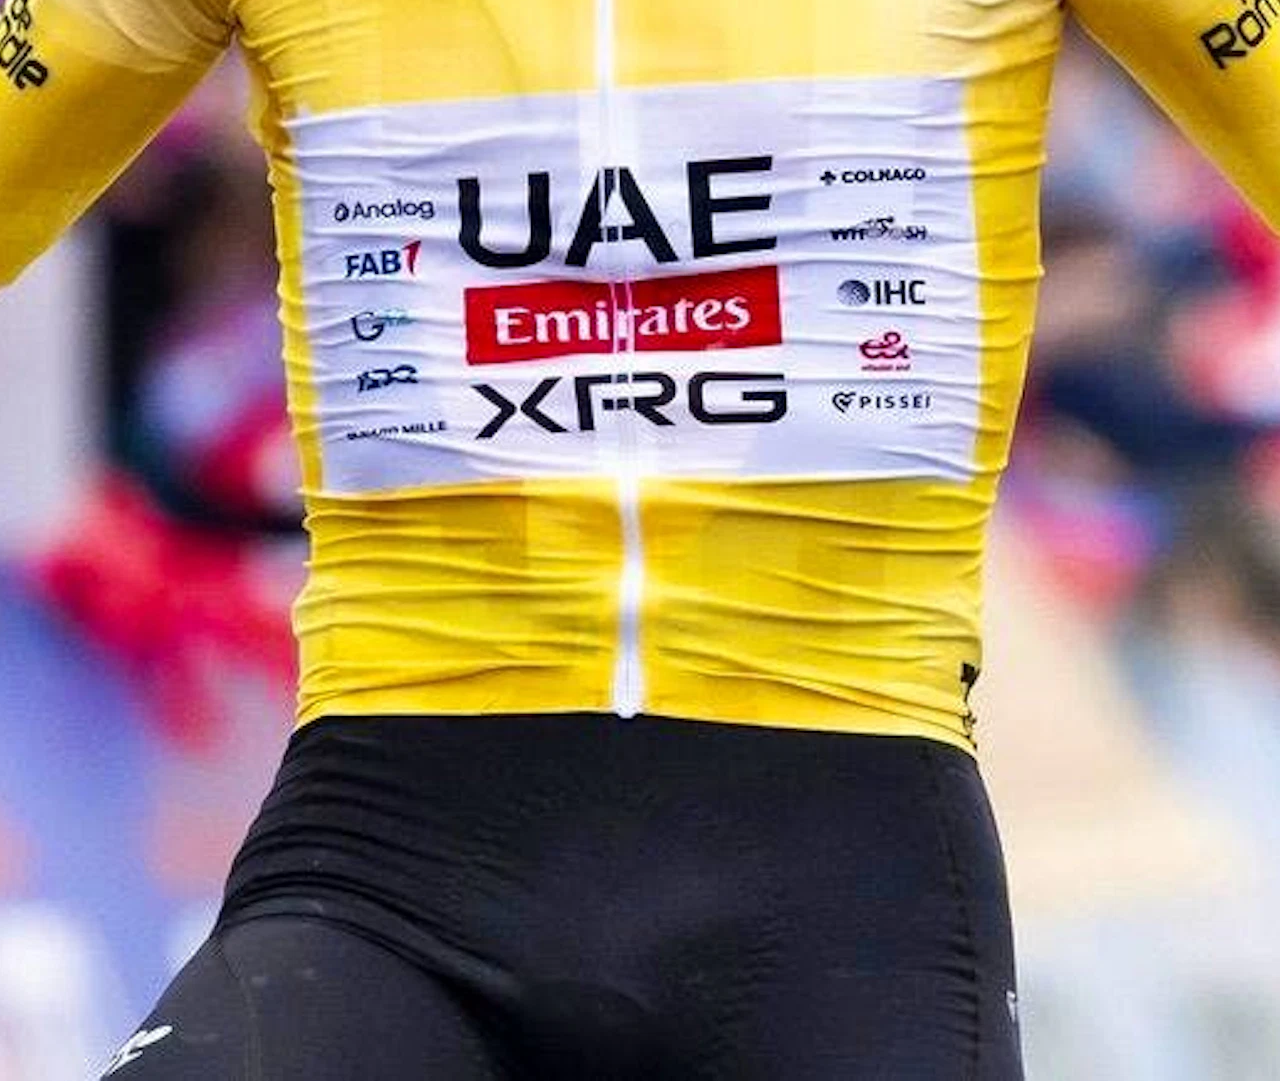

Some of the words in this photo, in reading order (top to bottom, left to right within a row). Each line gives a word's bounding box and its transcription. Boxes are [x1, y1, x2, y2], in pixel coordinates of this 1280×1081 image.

[352, 199, 436, 220] Analog
[458, 156, 778, 269] UAE
[875, 280, 926, 305] IHC
[494, 296, 752, 346] Emirates
[471, 372, 789, 440] XRG
[859, 395, 931, 409] PISSEI
